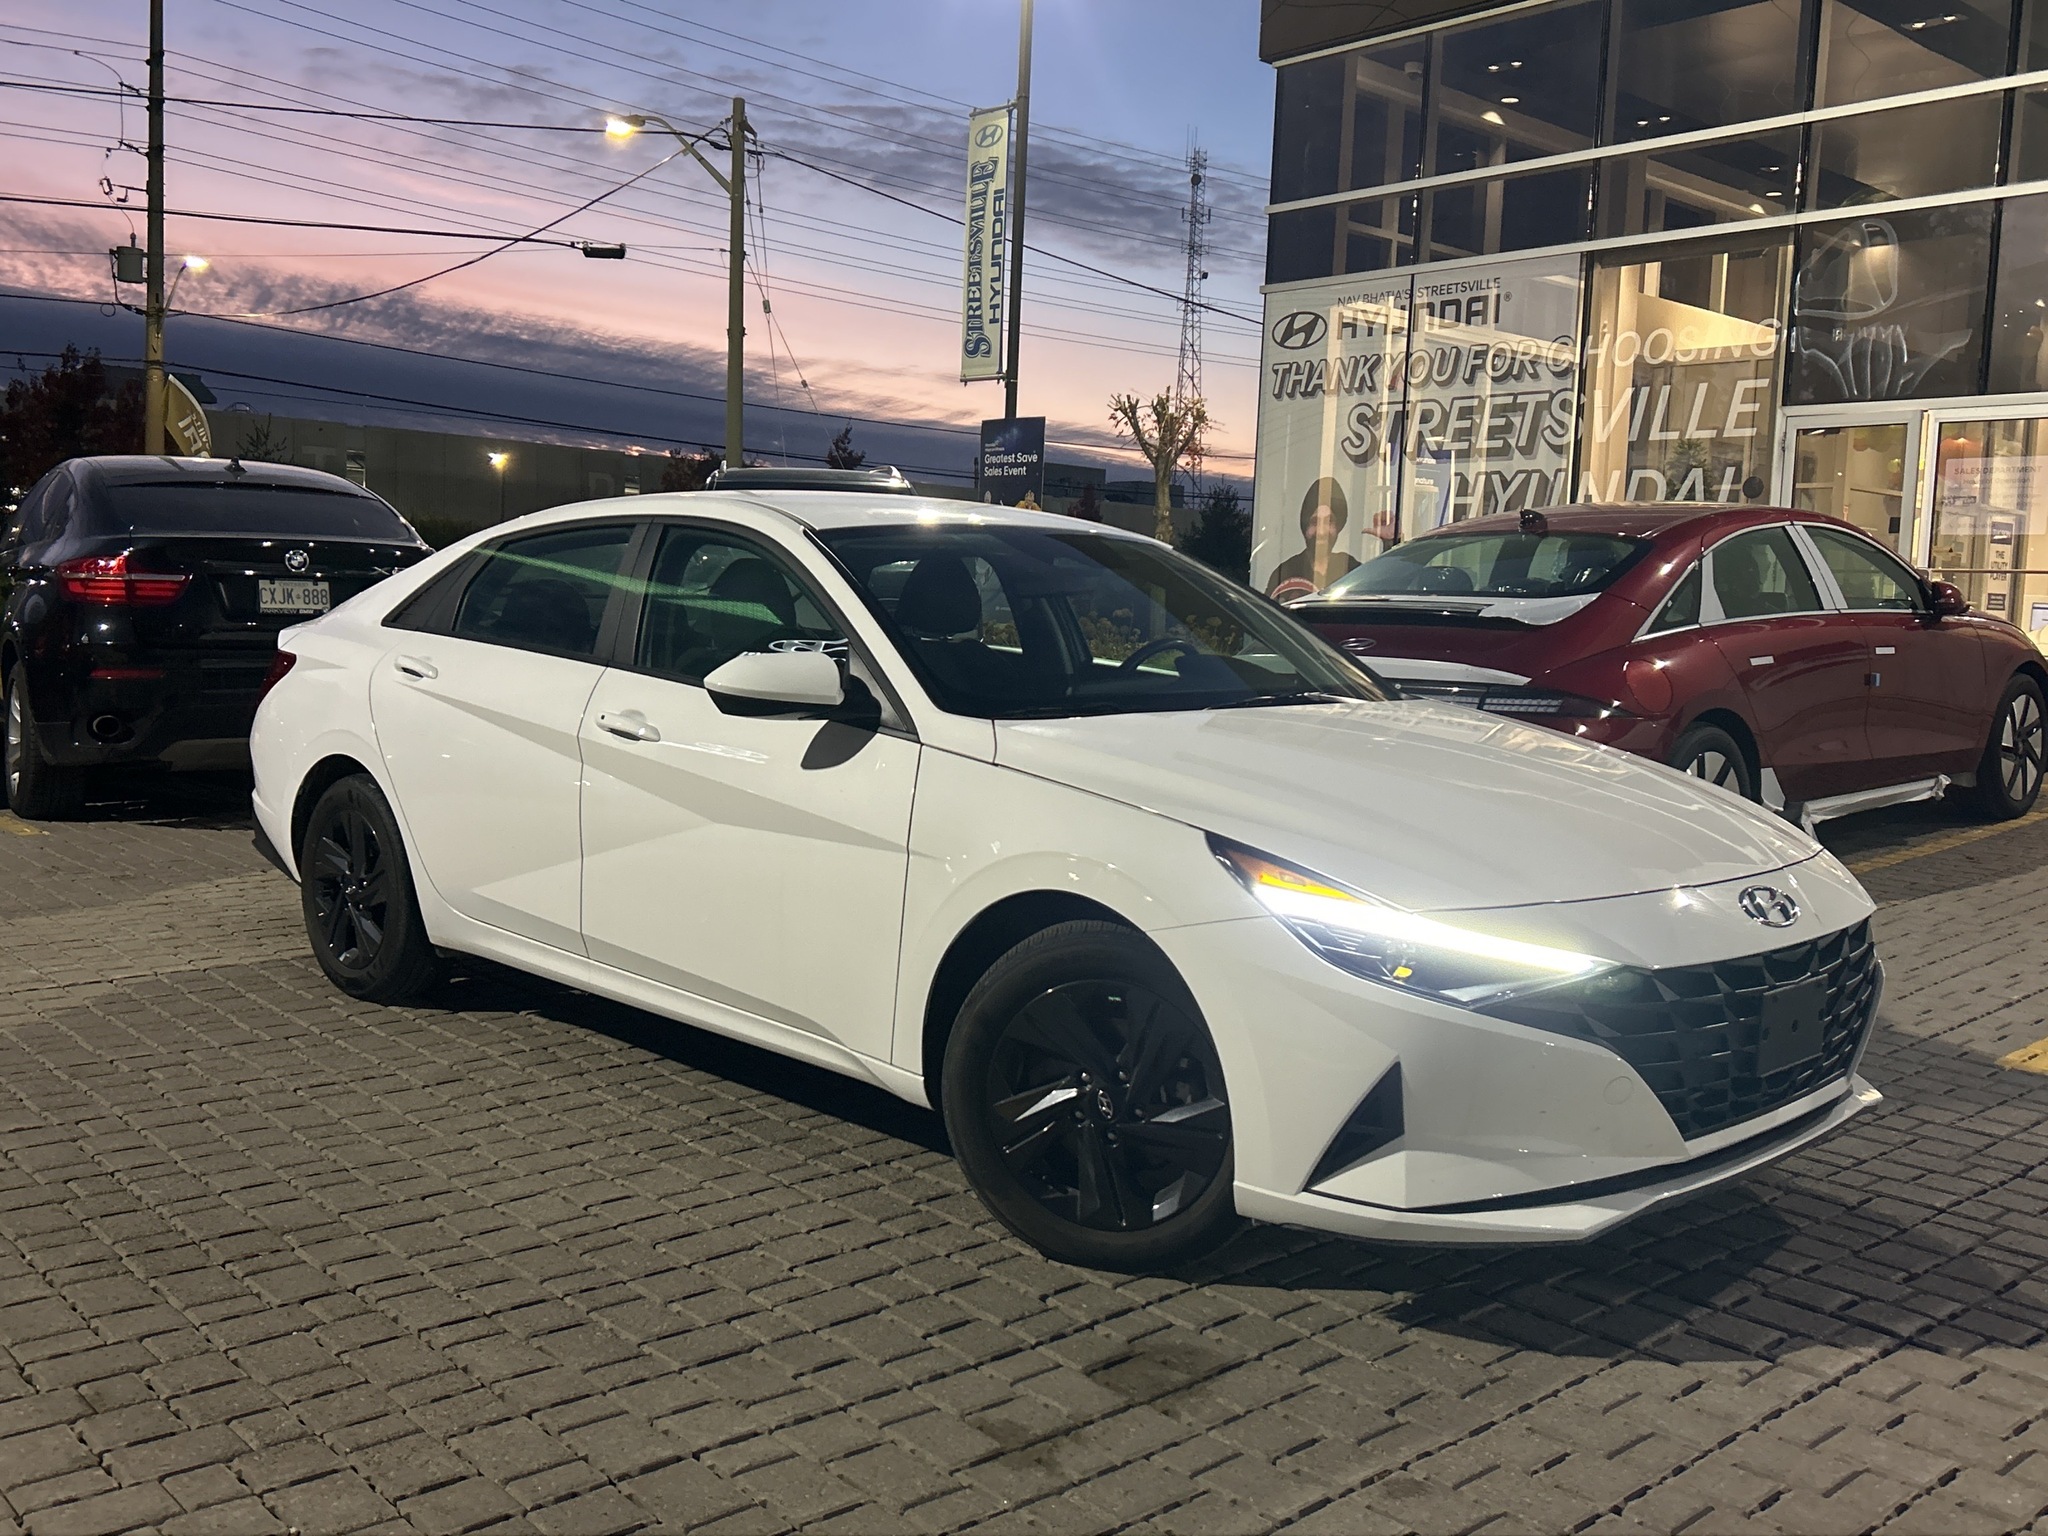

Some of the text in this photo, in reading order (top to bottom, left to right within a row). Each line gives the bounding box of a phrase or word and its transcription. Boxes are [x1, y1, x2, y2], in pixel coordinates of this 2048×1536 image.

[964, 156, 999, 359] STREETSVILLE
[988, 188, 1005, 325] HYUNDAI
[1338, 277, 1502, 307] NAV BHATIA'S STREETSVILLE
[1336, 293, 1501, 341] HYUNDAI
[1272, 318, 1782, 402] THANK YOU FOR CHOOSING
[1340, 378, 1770, 468] STREETSVILLE
[984, 452, 1038, 464] Greatest Save
[984, 465, 1027, 477] Sales Event
[1954, 465, 2043, 475] SALES DEPARTMENT
[260, 587, 329, 606] CXJK 888
